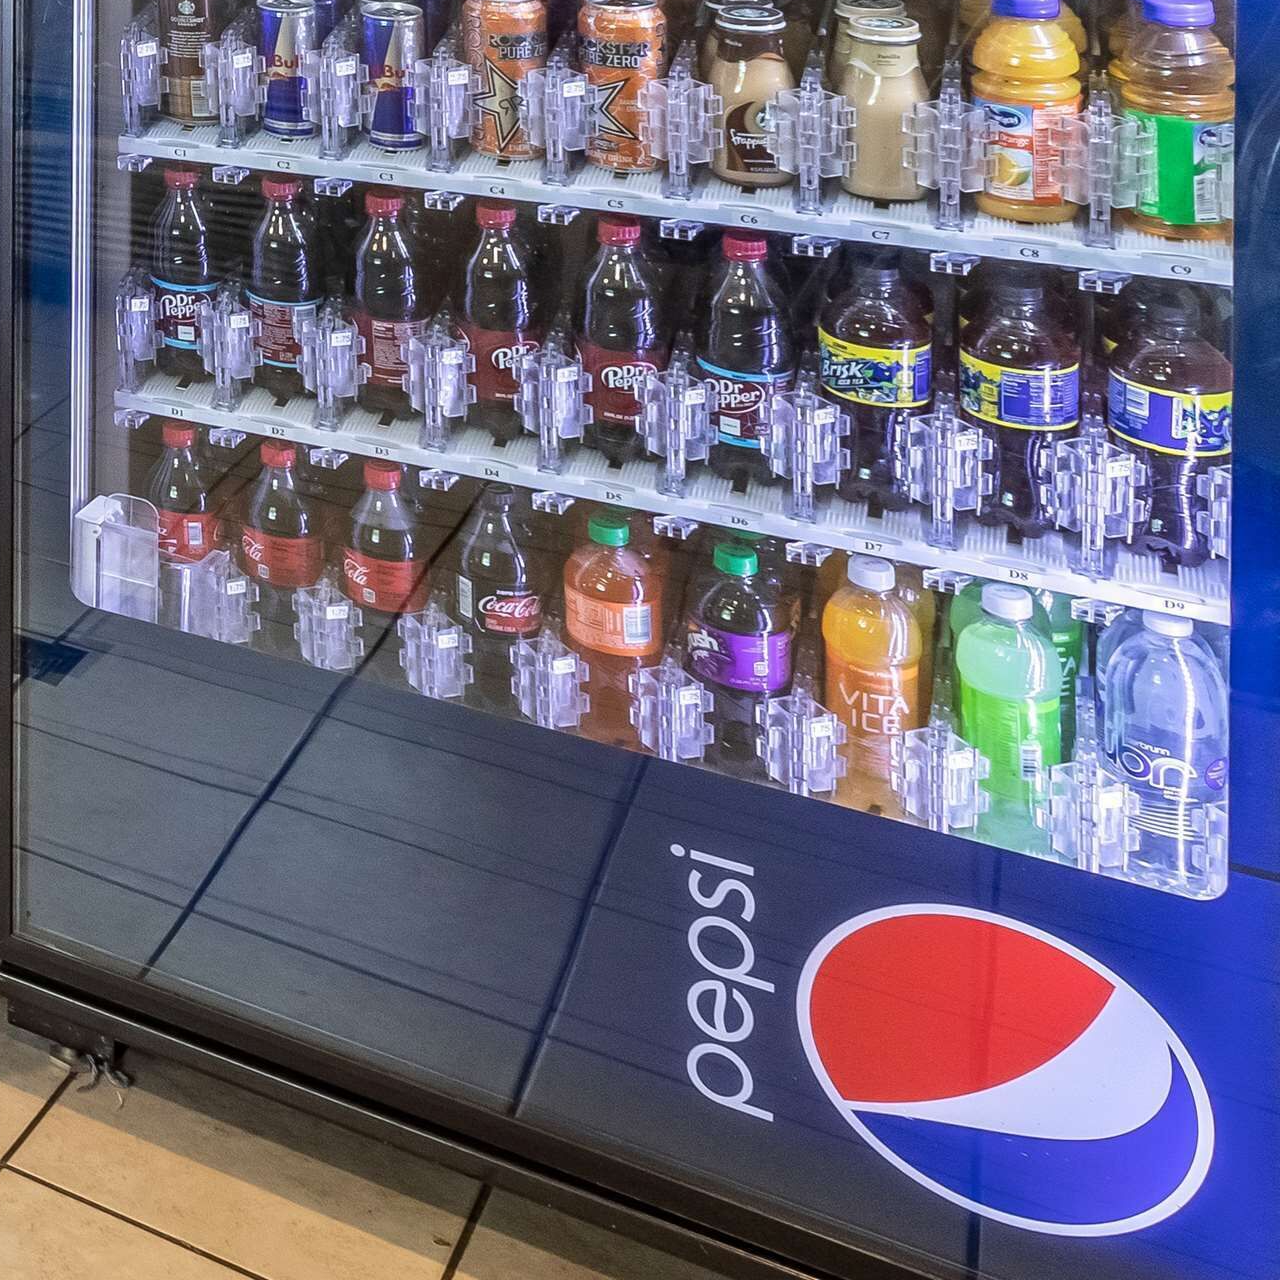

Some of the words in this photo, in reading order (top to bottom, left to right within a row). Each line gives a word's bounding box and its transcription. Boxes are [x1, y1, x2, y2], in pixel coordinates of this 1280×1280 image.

[606, 54, 641, 68] ZERO
[174, 148, 187, 158] C1
[277, 161, 290, 170] C2
[379, 173, 393, 182] C3
[490, 186, 505, 195] C4
[607, 199, 624, 208] C5
[740, 215, 758, 225] C6
[871, 230, 890, 240] C7
[1020, 247, 1040, 258] C8
[1171, 264, 1191, 276] C9
[176, 293, 196, 307] Dr
[171, 408, 184, 417] D1
[271, 427, 285, 436] D2
[375, 447, 389, 456] D3
[605, 491, 622, 501] D5
[864, 541, 882, 551] D7
[1009, 570, 1029, 581] D8
[1164, 600, 1186, 611] D9
[839, 682, 910, 715] VITA
[670, 843, 775, 1122] pepsi
